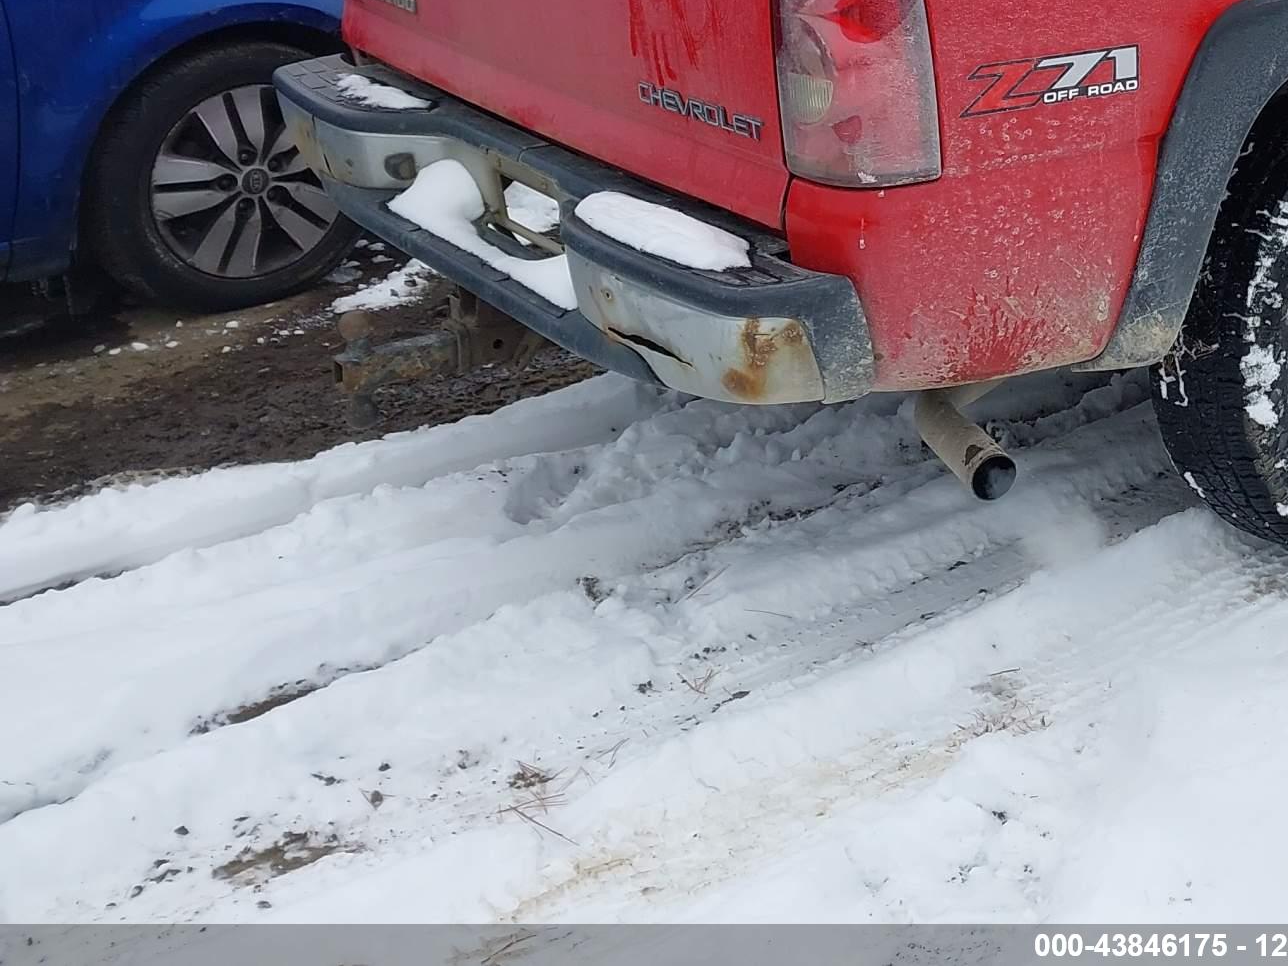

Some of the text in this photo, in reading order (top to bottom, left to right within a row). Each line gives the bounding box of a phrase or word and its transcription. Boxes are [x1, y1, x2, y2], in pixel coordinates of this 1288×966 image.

[638, 81, 763, 141] CHEVROLET
[960, 45, 1139, 117] Z71
[1043, 80, 1138, 104] OFF ROAD
